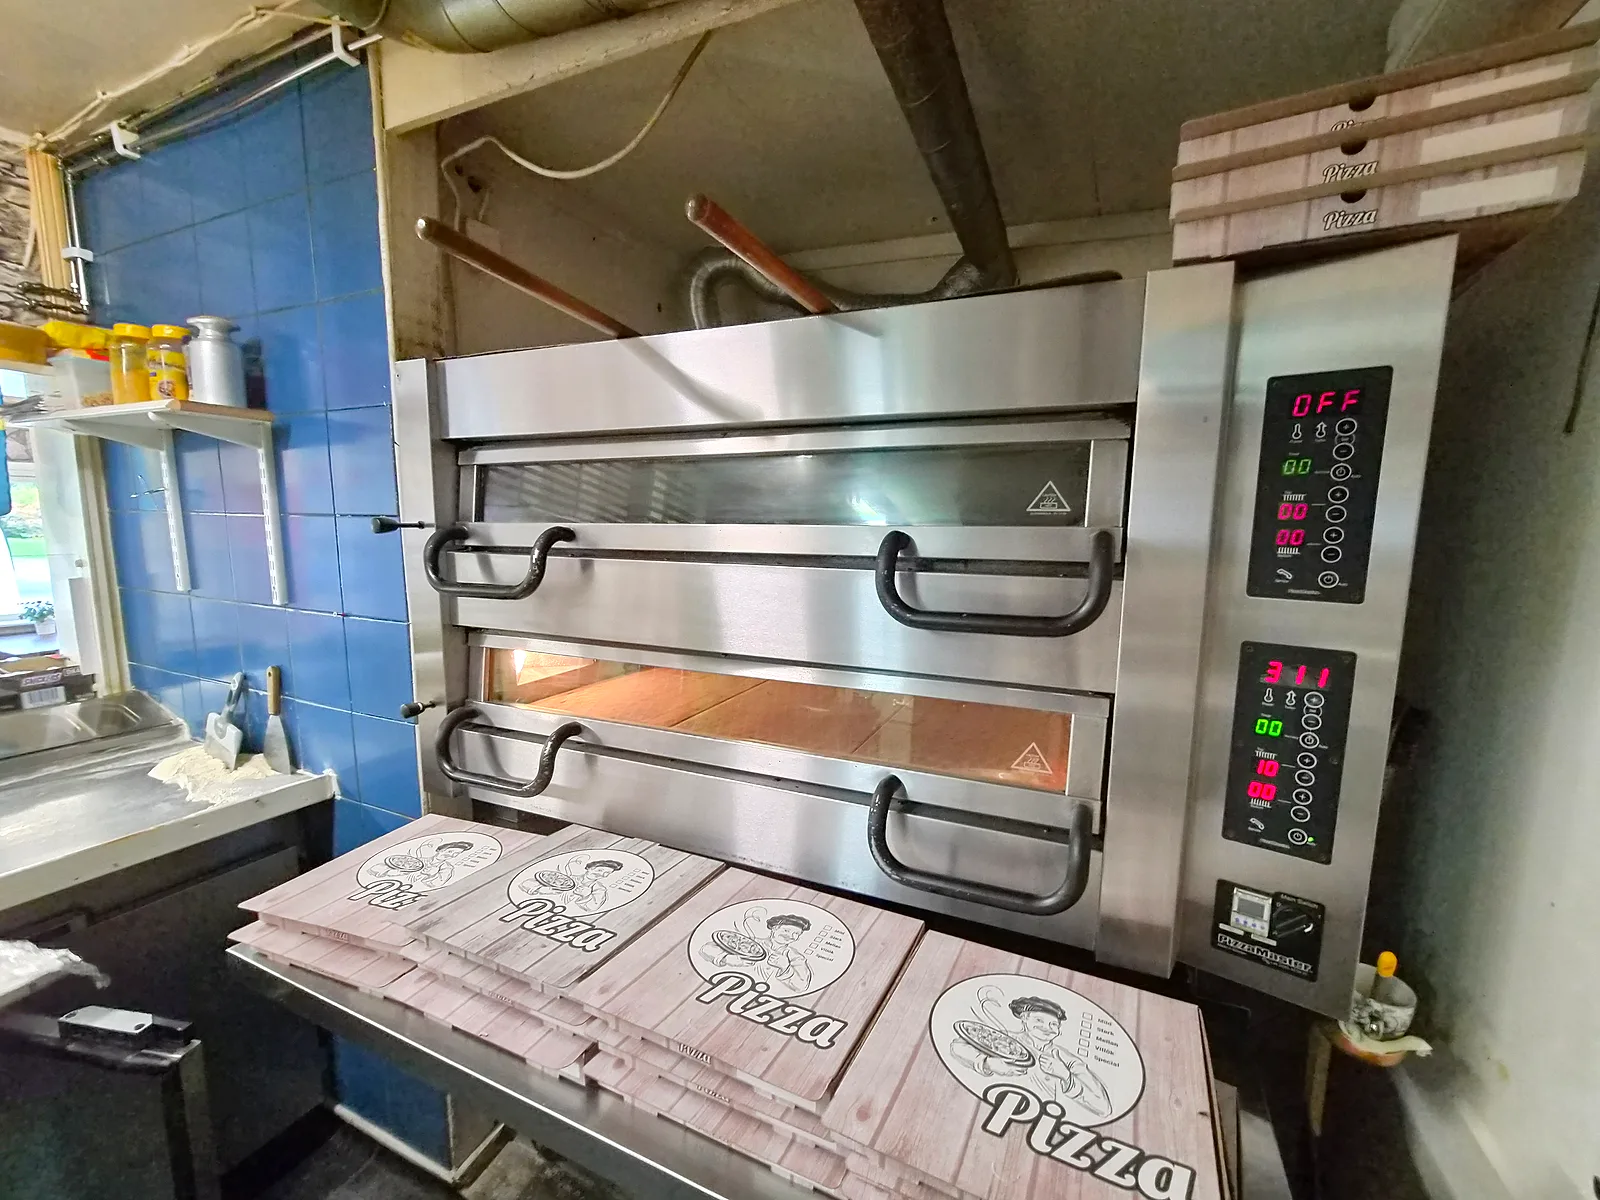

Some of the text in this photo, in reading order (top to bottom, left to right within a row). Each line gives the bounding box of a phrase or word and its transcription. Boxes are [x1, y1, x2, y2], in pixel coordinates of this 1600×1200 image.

[1323, 161, 1379, 184] Pizza
[1323, 209, 1379, 231] Pizza
[1292, 389, 1361, 418] OFF
[1277, 502, 1309, 521] 00
[1275, 528, 1305, 546] 00
[1263, 661, 1330, 689] 311
[1255, 718, 1283, 737] 00
[1256, 759, 1280, 778] 10
[1247, 781, 1277, 802] 00
[347, 879, 428, 912] Piz
[499, 898, 618, 953] Pizza
[695, 971, 849, 1050] Pizza
[981, 1083, 1198, 1200] Pizza
